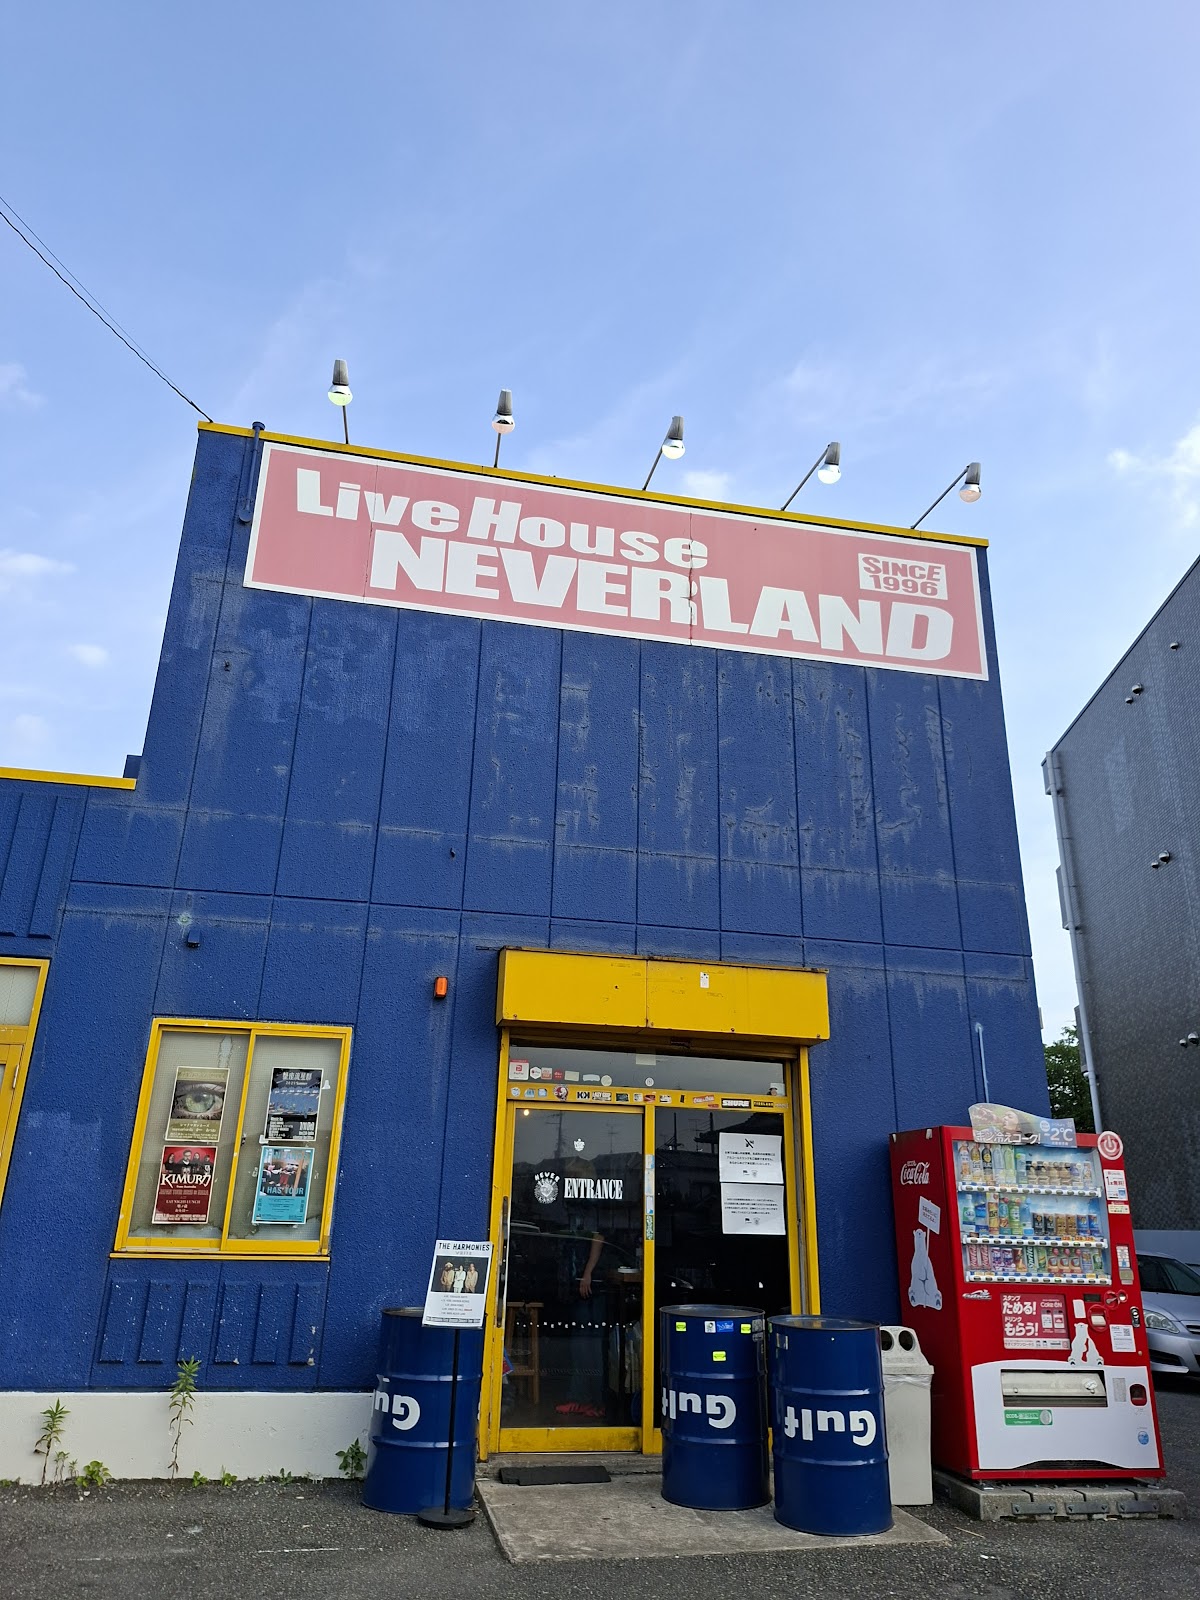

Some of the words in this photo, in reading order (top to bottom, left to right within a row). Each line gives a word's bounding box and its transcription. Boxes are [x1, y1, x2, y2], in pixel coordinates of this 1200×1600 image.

[862, 556, 942, 581] SINCE
[869, 575, 938, 597] 1996
[370, 529, 954, 662] NEVERLAND
[722, 1099, 750, 1108] SHURE
[534, 1171, 560, 1182] NEVER
[564, 1178, 623, 1199] ENTRANCE
[453, 1244, 490, 1252] HARMONIES
[1003, 1301, 1036, 1315] ためる!
[1005, 1322, 1039, 1336] もらう!
[784, 1405, 877, 1447] Gulf
